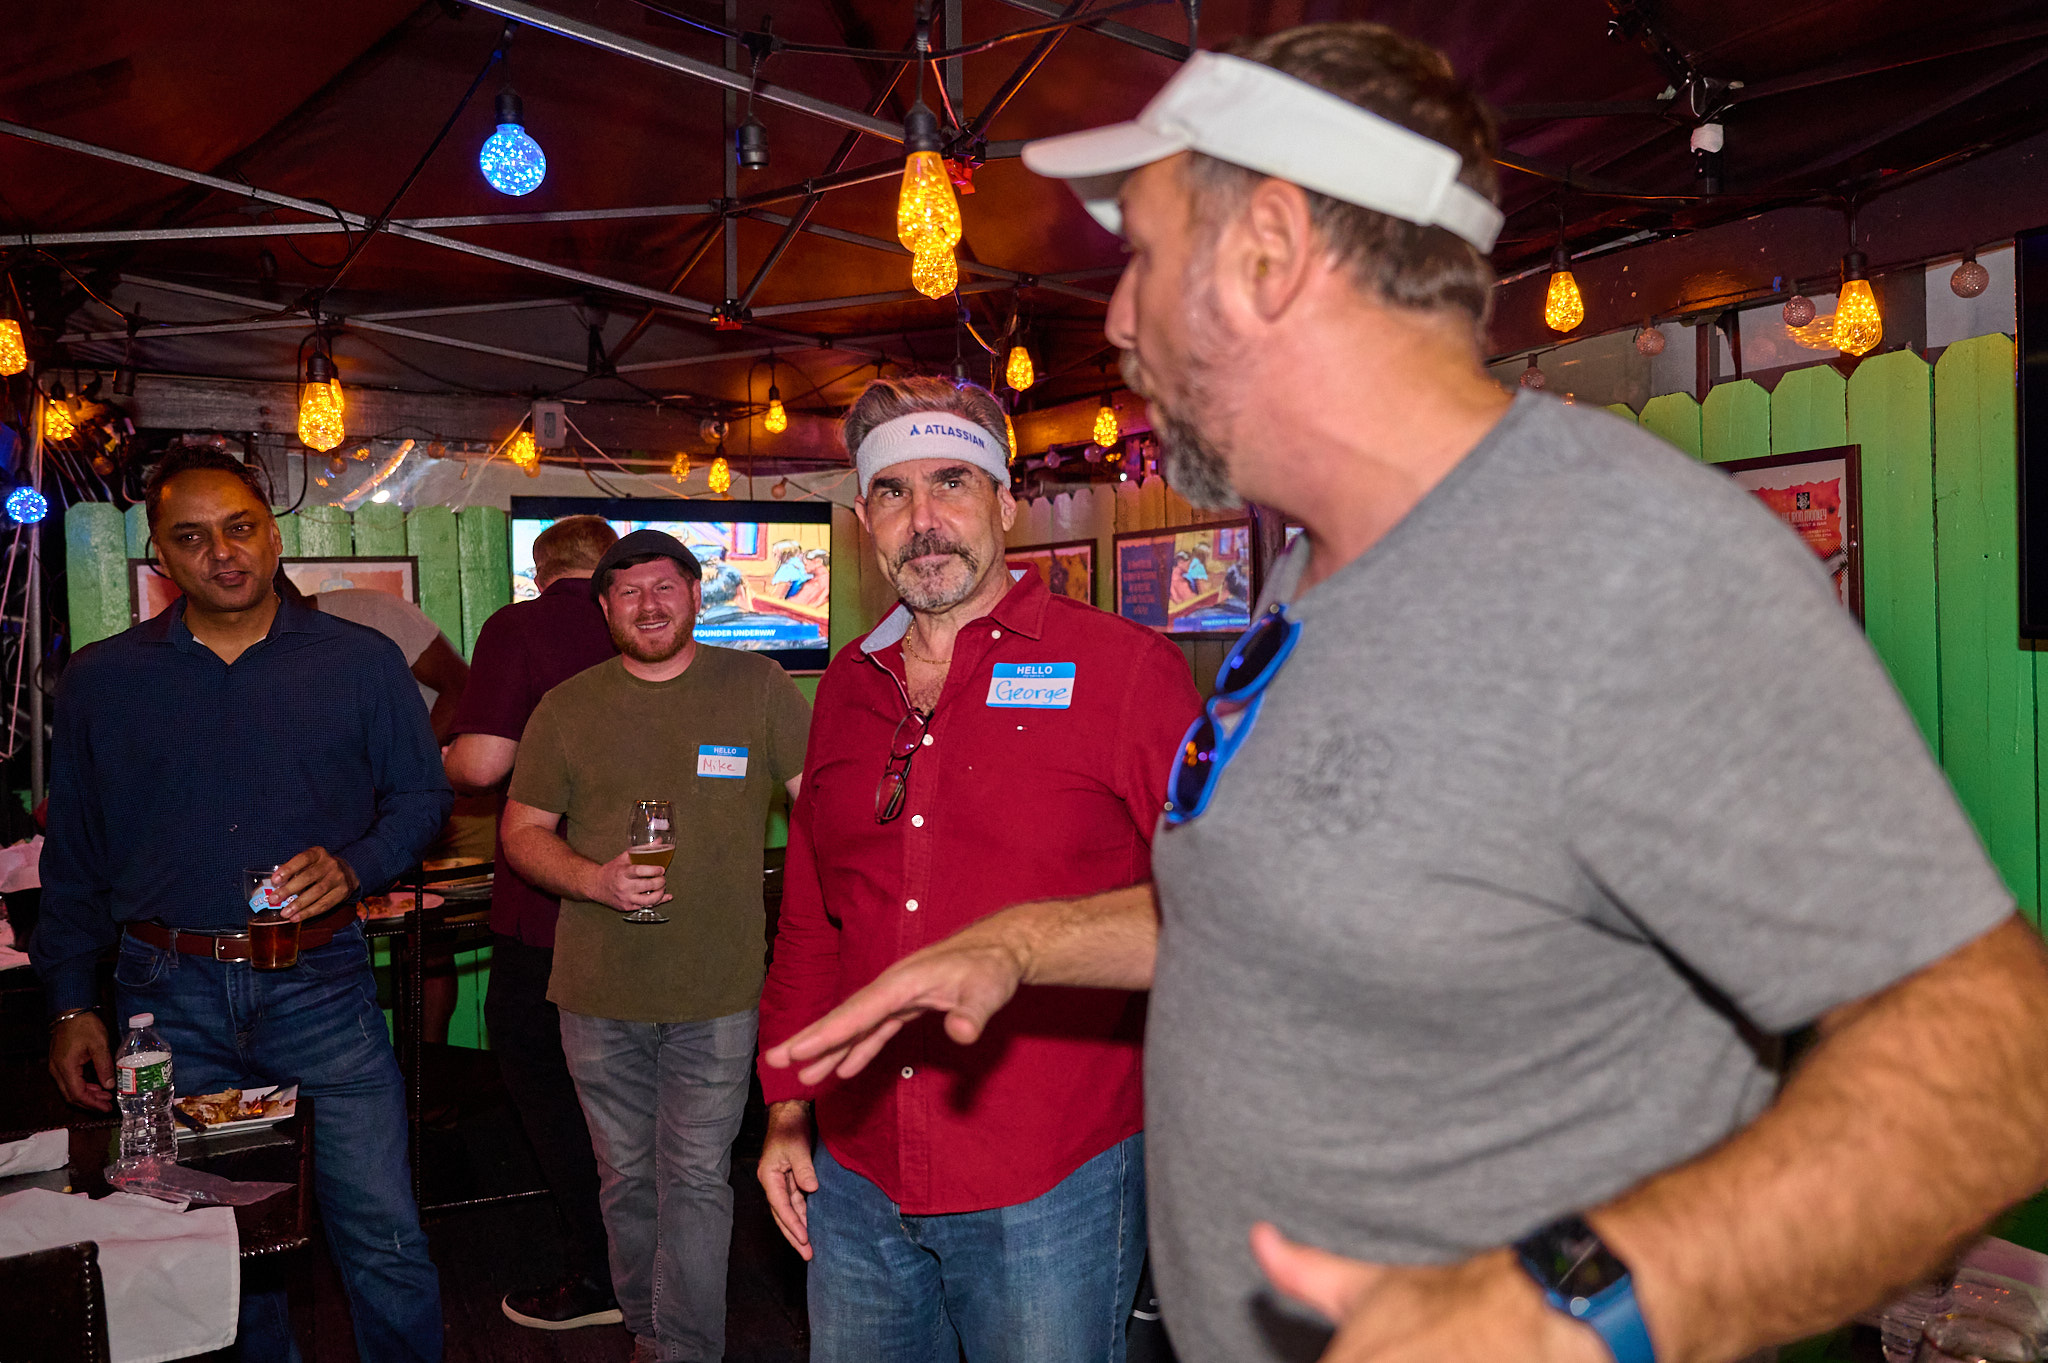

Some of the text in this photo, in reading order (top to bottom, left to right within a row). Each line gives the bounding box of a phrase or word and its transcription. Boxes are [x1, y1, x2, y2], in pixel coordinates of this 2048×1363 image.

[925, 424, 985, 449] ATLASSIAN
[693, 629, 776, 638] FOUNDER UNDERWAY
[1016, 665, 1053, 675] HELLO
[995, 680, 1070, 704] George
[713, 747, 737, 755] HELLO
[703, 757, 736, 773] Mike
